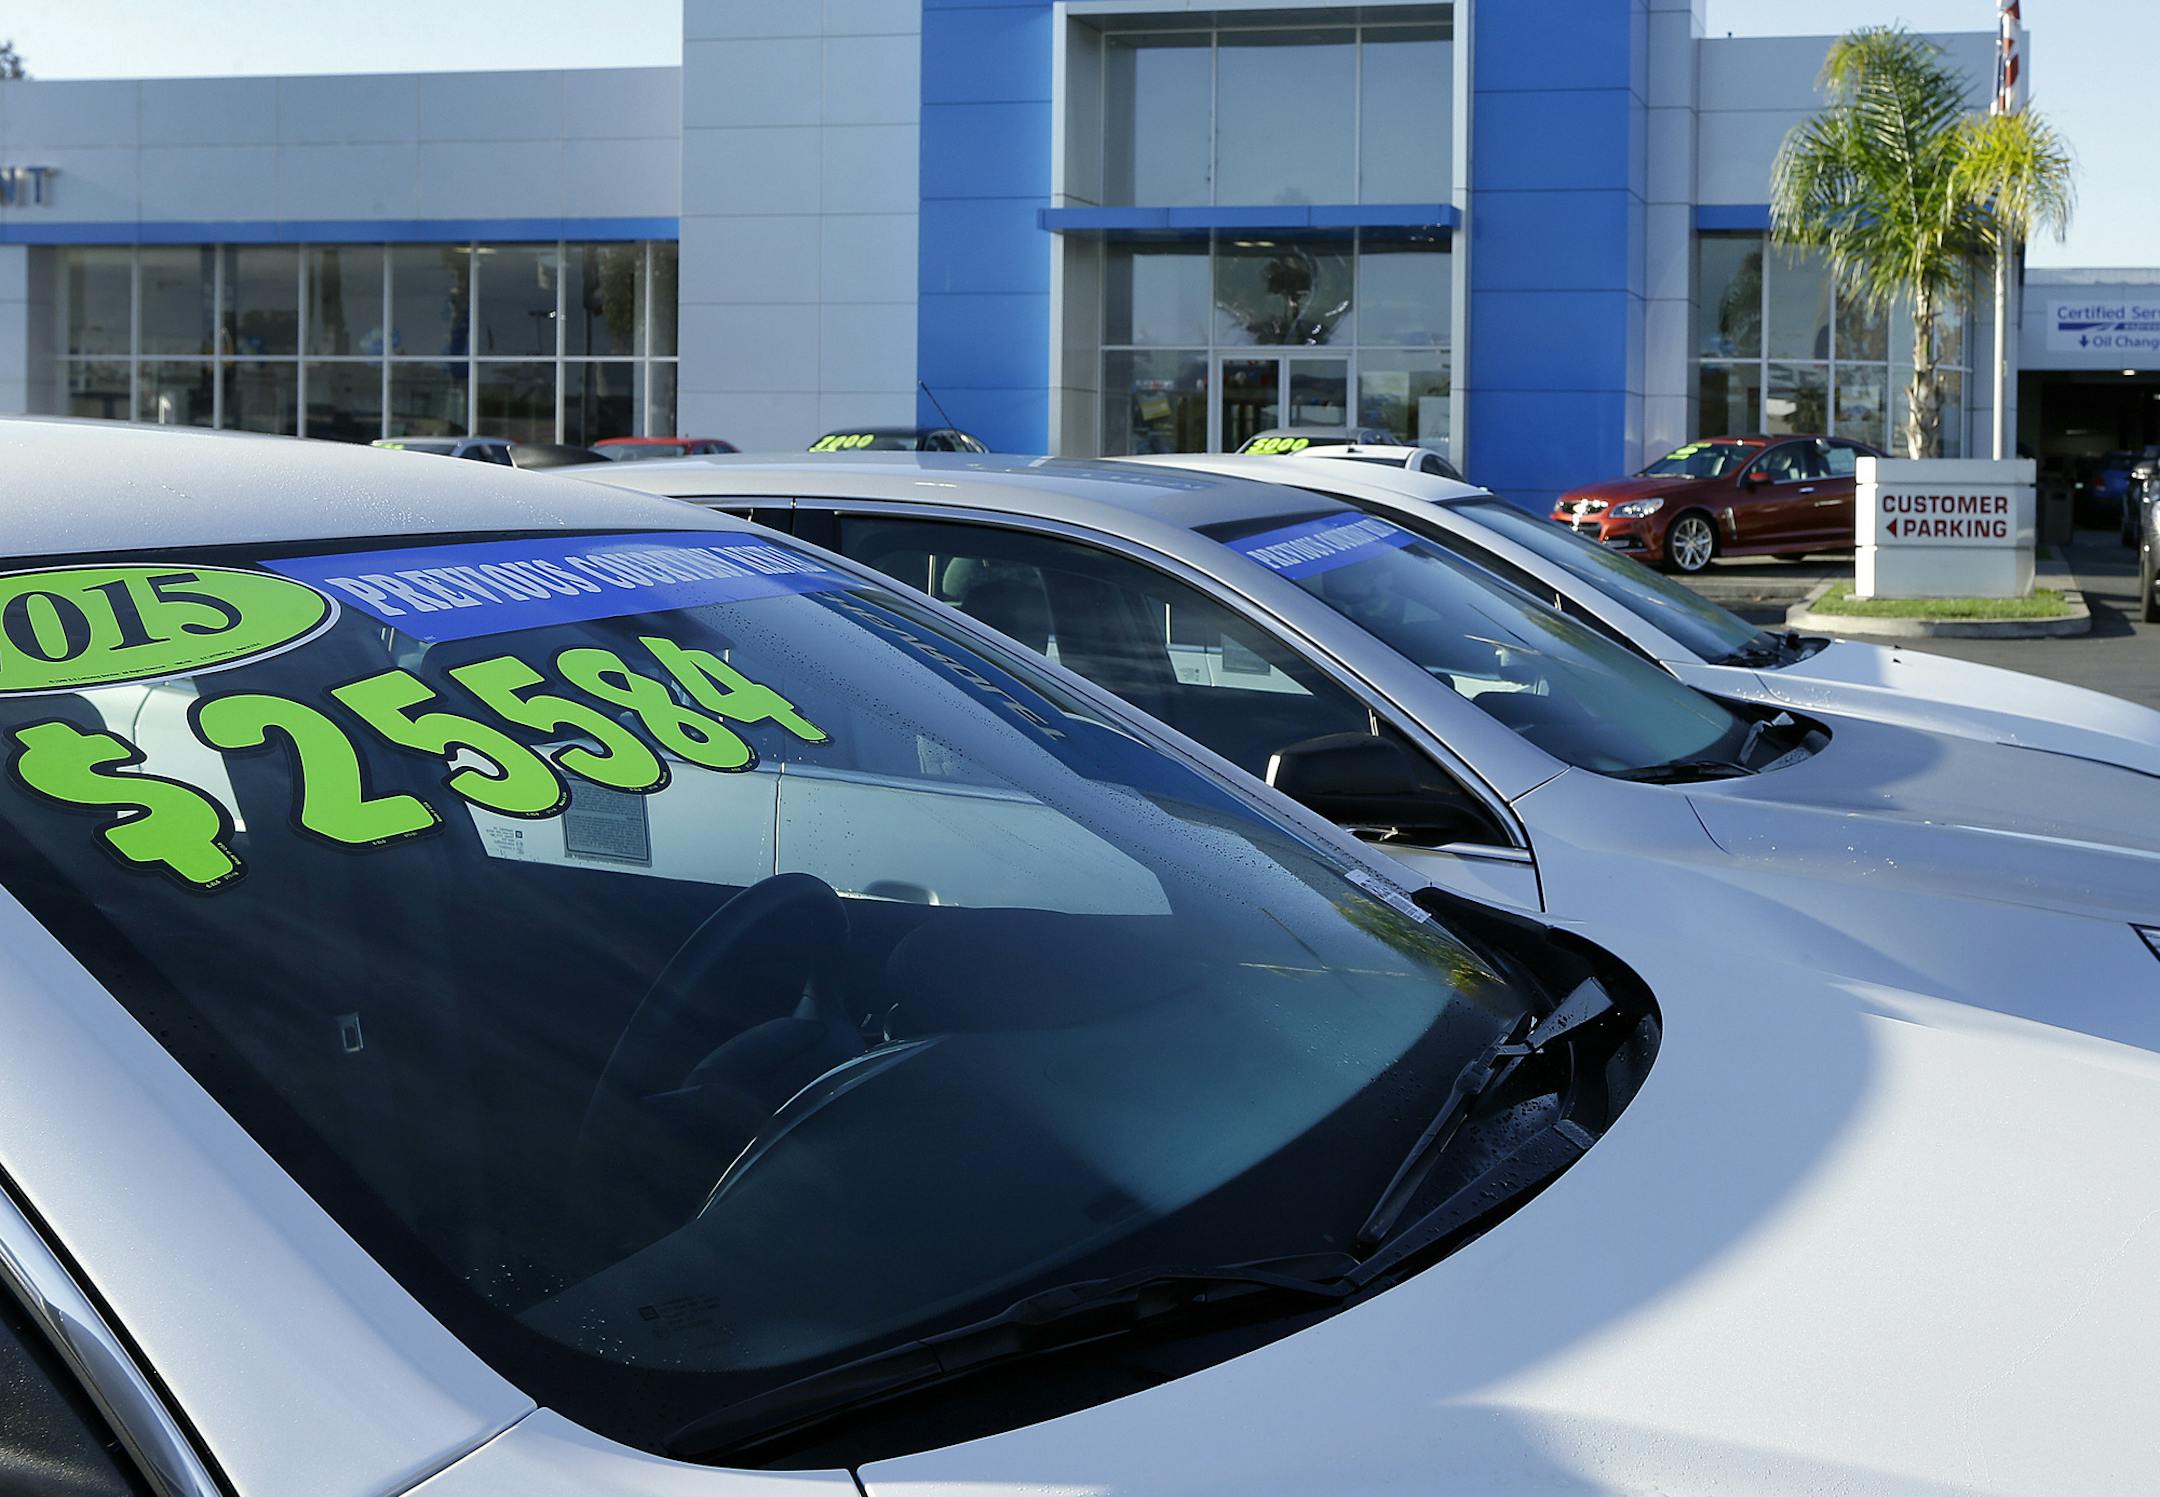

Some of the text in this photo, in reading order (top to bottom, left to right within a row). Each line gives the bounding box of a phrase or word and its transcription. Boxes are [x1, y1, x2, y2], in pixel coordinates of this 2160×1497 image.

[2057, 305, 2160, 320] Certified Ser
[2092, 335, 2112, 347] Oil
[1881, 495, 2009, 514] CUSTOMER
[1902, 519, 2007, 538] PARKING
[325, 559, 602, 617] PREVIOUS
[0, 572, 243, 672] 015
